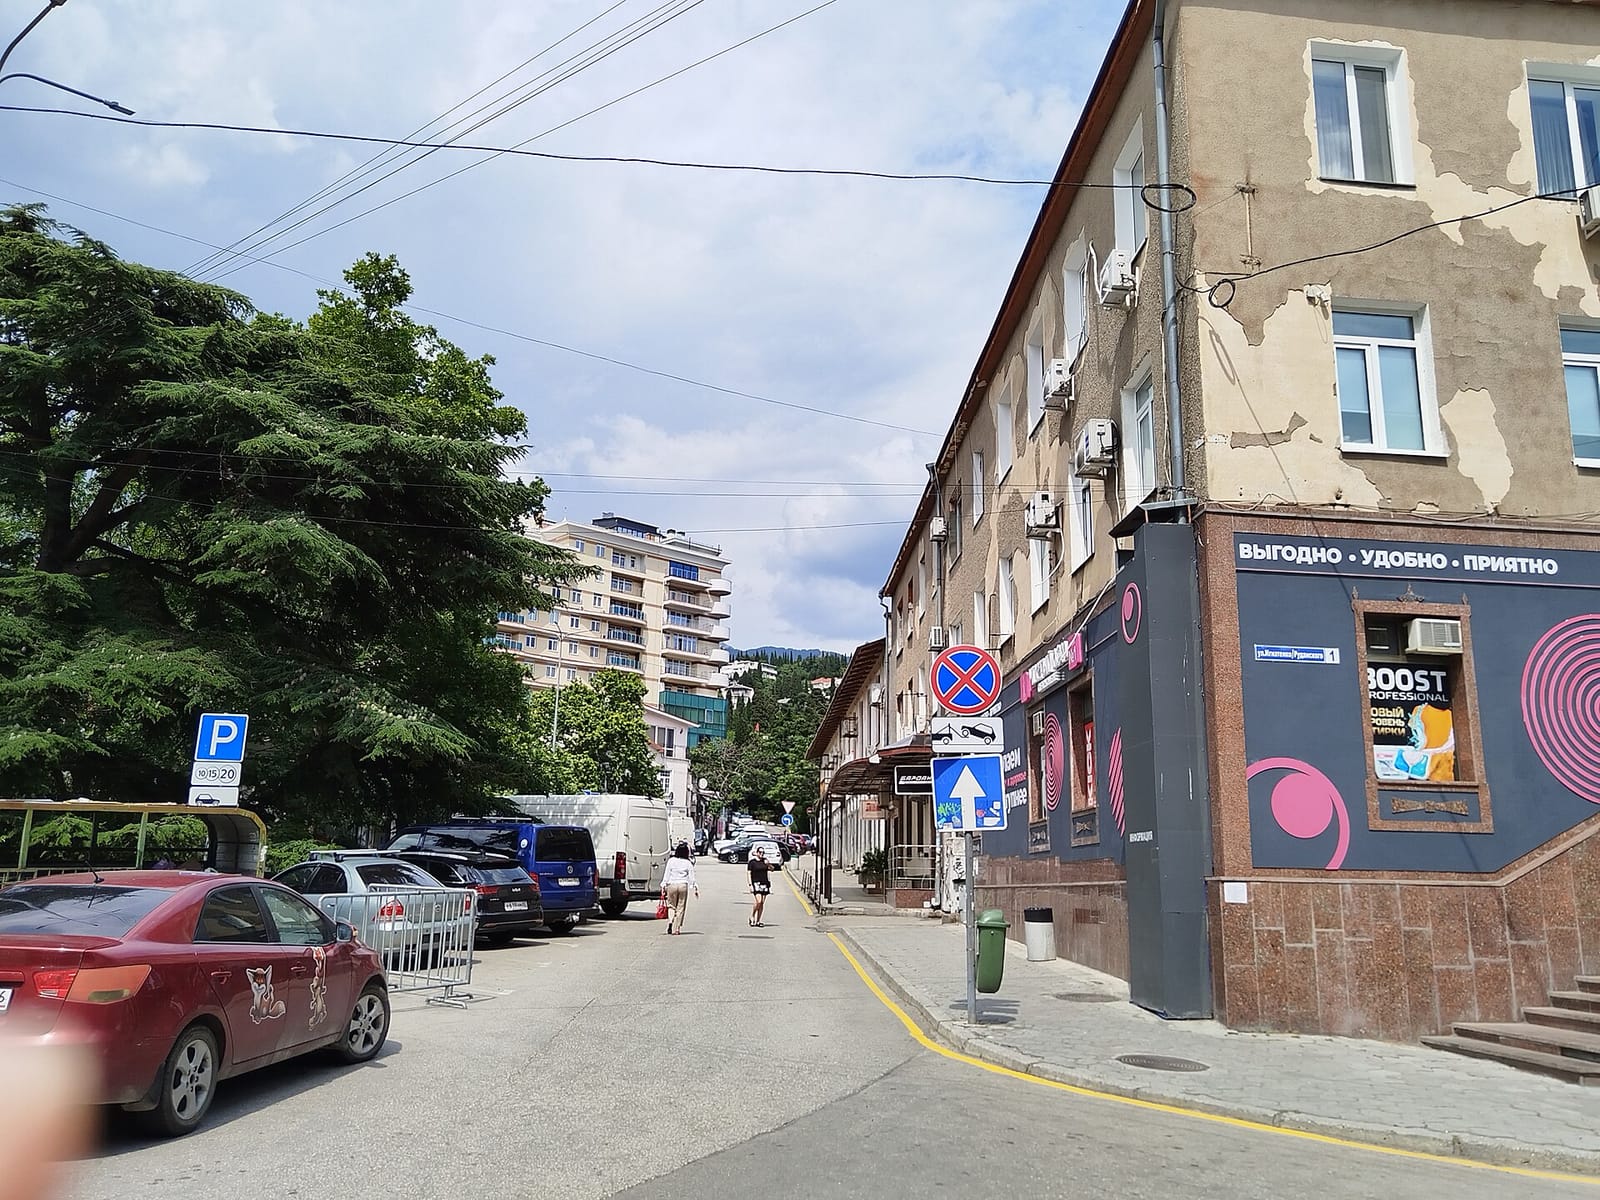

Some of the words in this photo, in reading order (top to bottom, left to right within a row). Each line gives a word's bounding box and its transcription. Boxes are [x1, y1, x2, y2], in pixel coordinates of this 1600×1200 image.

[1238, 543, 1343, 565] ВЫГОДНО
[1360, 549, 1448, 570] УДОБНО
[1463, 554, 1559, 575] ПРИЯТНО
[1329, 650, 1335, 662] 1
[1367, 668, 1447, 692] BOOST
[1368, 691, 1449, 702] ROFESSIONAL
[1370, 706, 1404, 718] ОВЫЙ
[1370, 717, 1405, 727] РОВЕНЬ
[209, 719, 238, 756] P
[1372, 727, 1406, 736] ТИРКИ
[198, 769, 206, 777] 10
[208, 769, 217, 778] 15
[220, 768, 235, 779] 20
